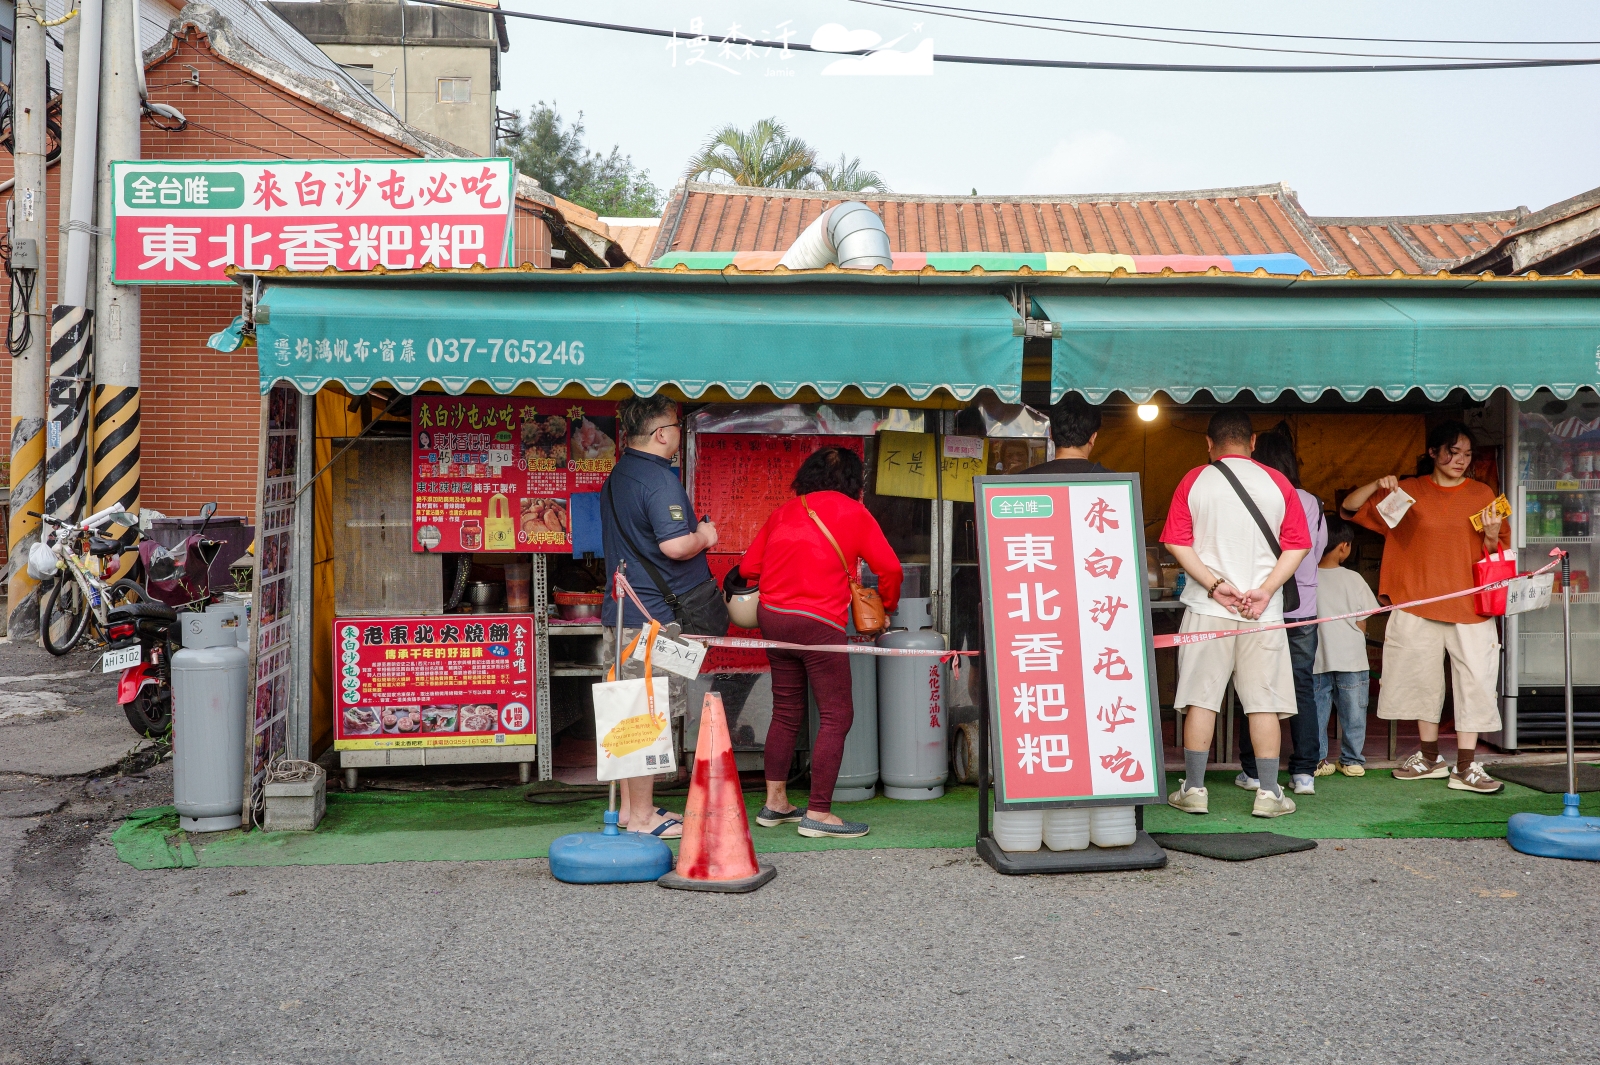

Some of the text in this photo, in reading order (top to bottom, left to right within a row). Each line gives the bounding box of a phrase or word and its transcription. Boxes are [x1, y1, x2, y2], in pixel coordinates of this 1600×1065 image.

[131, 175, 236, 205] 全台唯一
[253, 166, 502, 212] 來白沙屯必吃
[137, 223, 486, 271] 東北香粑粑
[427, 337, 585, 365] 037-765246
[418, 402, 517, 430] 來白沙屯必吃
[433, 433, 491, 450] 東北香粑粑
[438, 451, 451, 464] 45
[490, 452, 509, 463] 130
[528, 458, 556, 472] 香粑粑
[999, 500, 1051, 514] 全台唯一
[527, 531, 565, 545] 大甲芋頭
[363, 623, 509, 645] 老東北火燒餅
[343, 626, 359, 703] 來白沙屯必吃
[385, 647, 484, 660] 傳承千年的好滋味
[1003, 533, 1074, 775] 東北香粑粑
[928, 665, 941, 728] 液化石油氣
[1412, 762, 1428, 773] N
[1465, 773, 1480, 784] N
